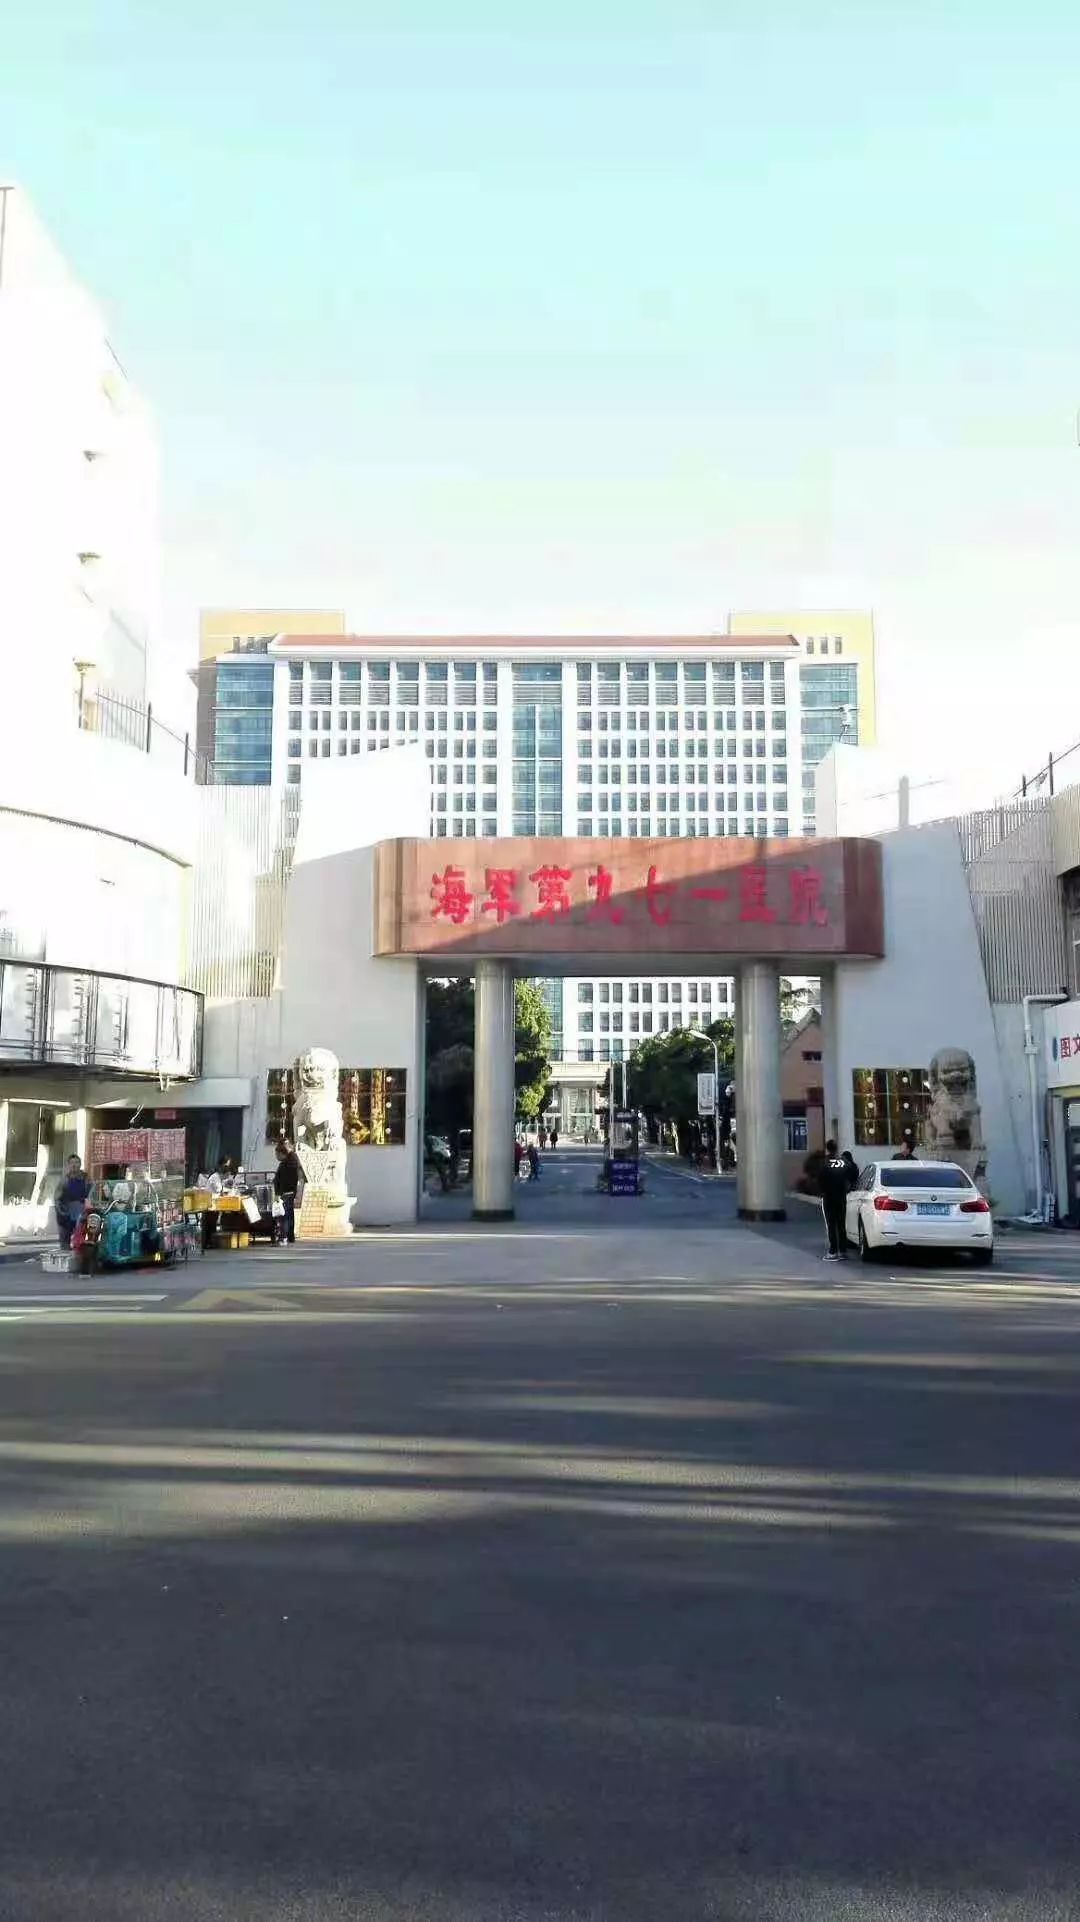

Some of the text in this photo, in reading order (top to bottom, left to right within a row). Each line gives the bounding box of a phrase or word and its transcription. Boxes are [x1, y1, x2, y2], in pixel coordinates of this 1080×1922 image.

[431, 864, 827, 927] 海军第九七一医院
